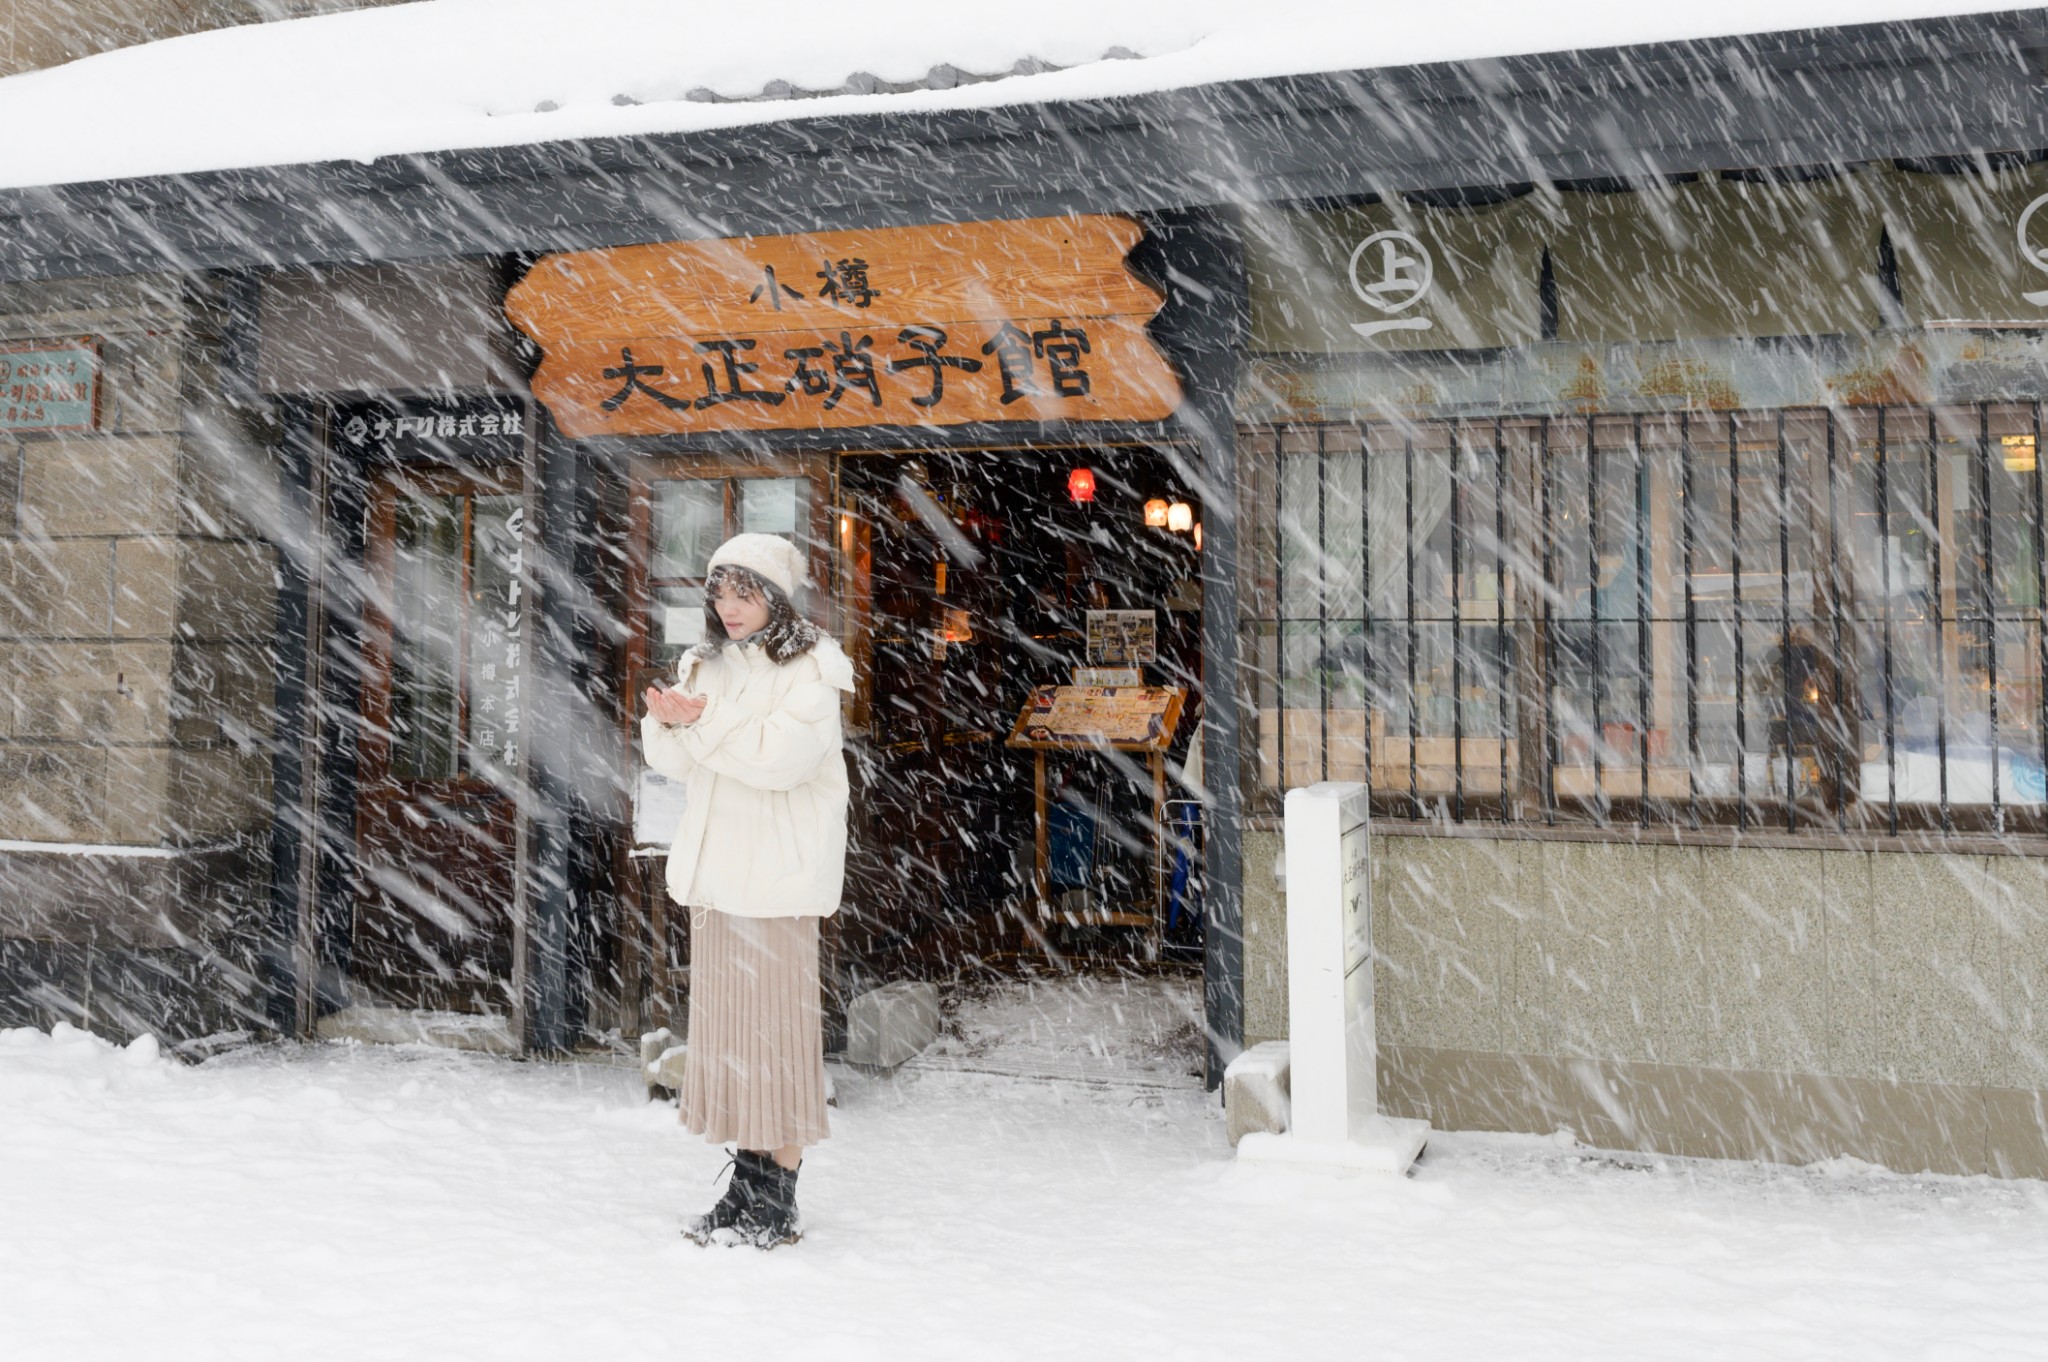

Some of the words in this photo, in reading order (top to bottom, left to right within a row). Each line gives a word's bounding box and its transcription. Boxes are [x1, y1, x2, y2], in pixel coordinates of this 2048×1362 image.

[749, 257, 881, 312] 小樽
[600, 318, 1092, 412] 大正硝子館
[374, 412, 524, 441] ナトリ株式会社
[480, 629, 498, 747] 小樽本店
